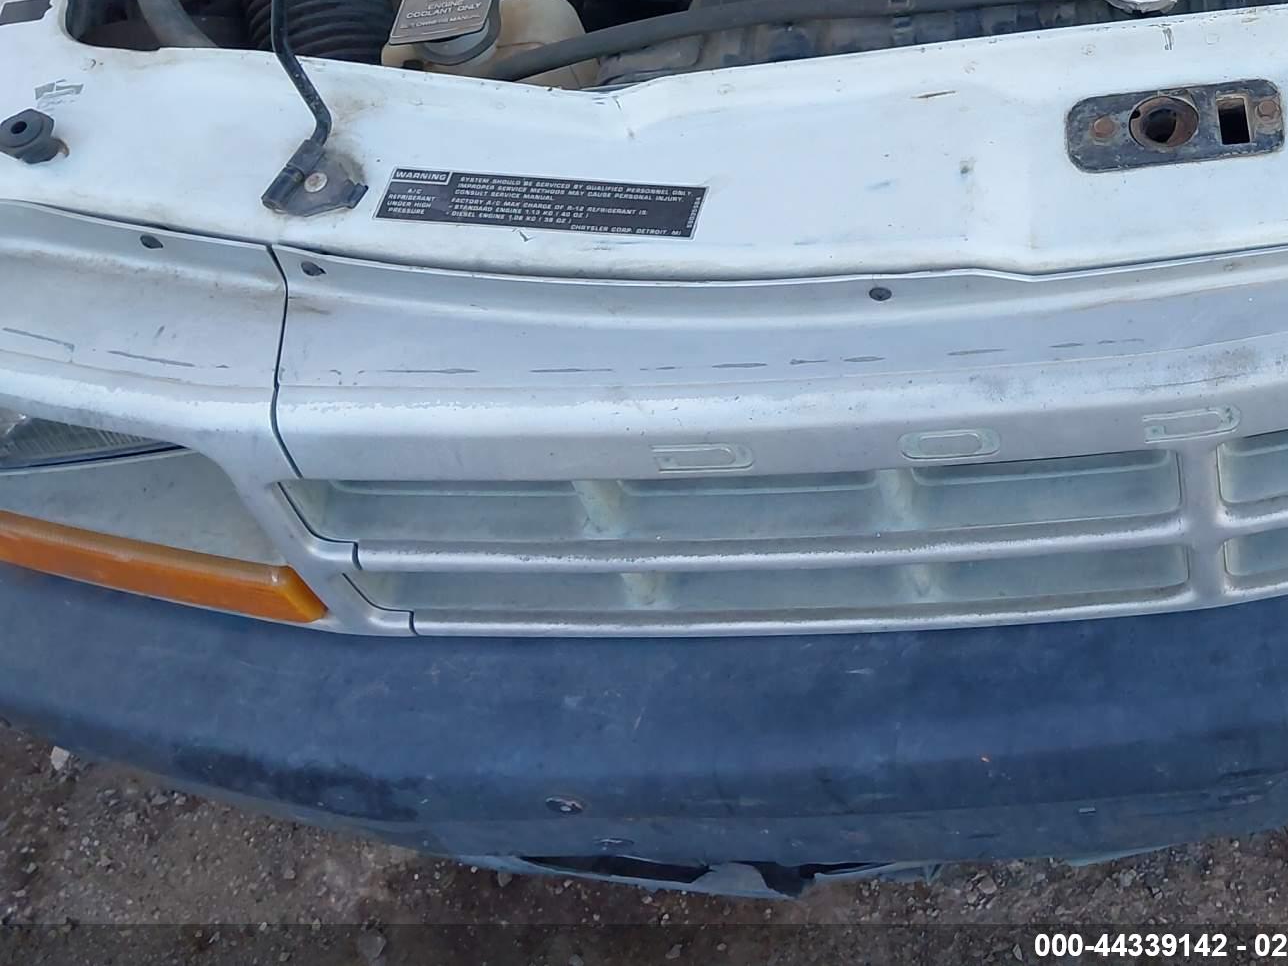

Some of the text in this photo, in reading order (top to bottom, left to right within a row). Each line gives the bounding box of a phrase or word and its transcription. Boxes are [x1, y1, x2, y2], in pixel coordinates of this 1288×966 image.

[428, 0, 464, 10] ENGINE
[406, 2, 482, 18] COOLANT ONLY
[396, 171, 448, 181] WARNING
[535, 180, 570, 189] SERVICED
[626, 187, 669, 195] PERSONNEL
[490, 190, 520, 198] SERVICE
[614, 192, 652, 200] PERSONAL
[388, 207, 425, 215] PRESSURE
[588, 206, 636, 215] REFRIGERANT
[570, 224, 609, 232] CHRYSLER
